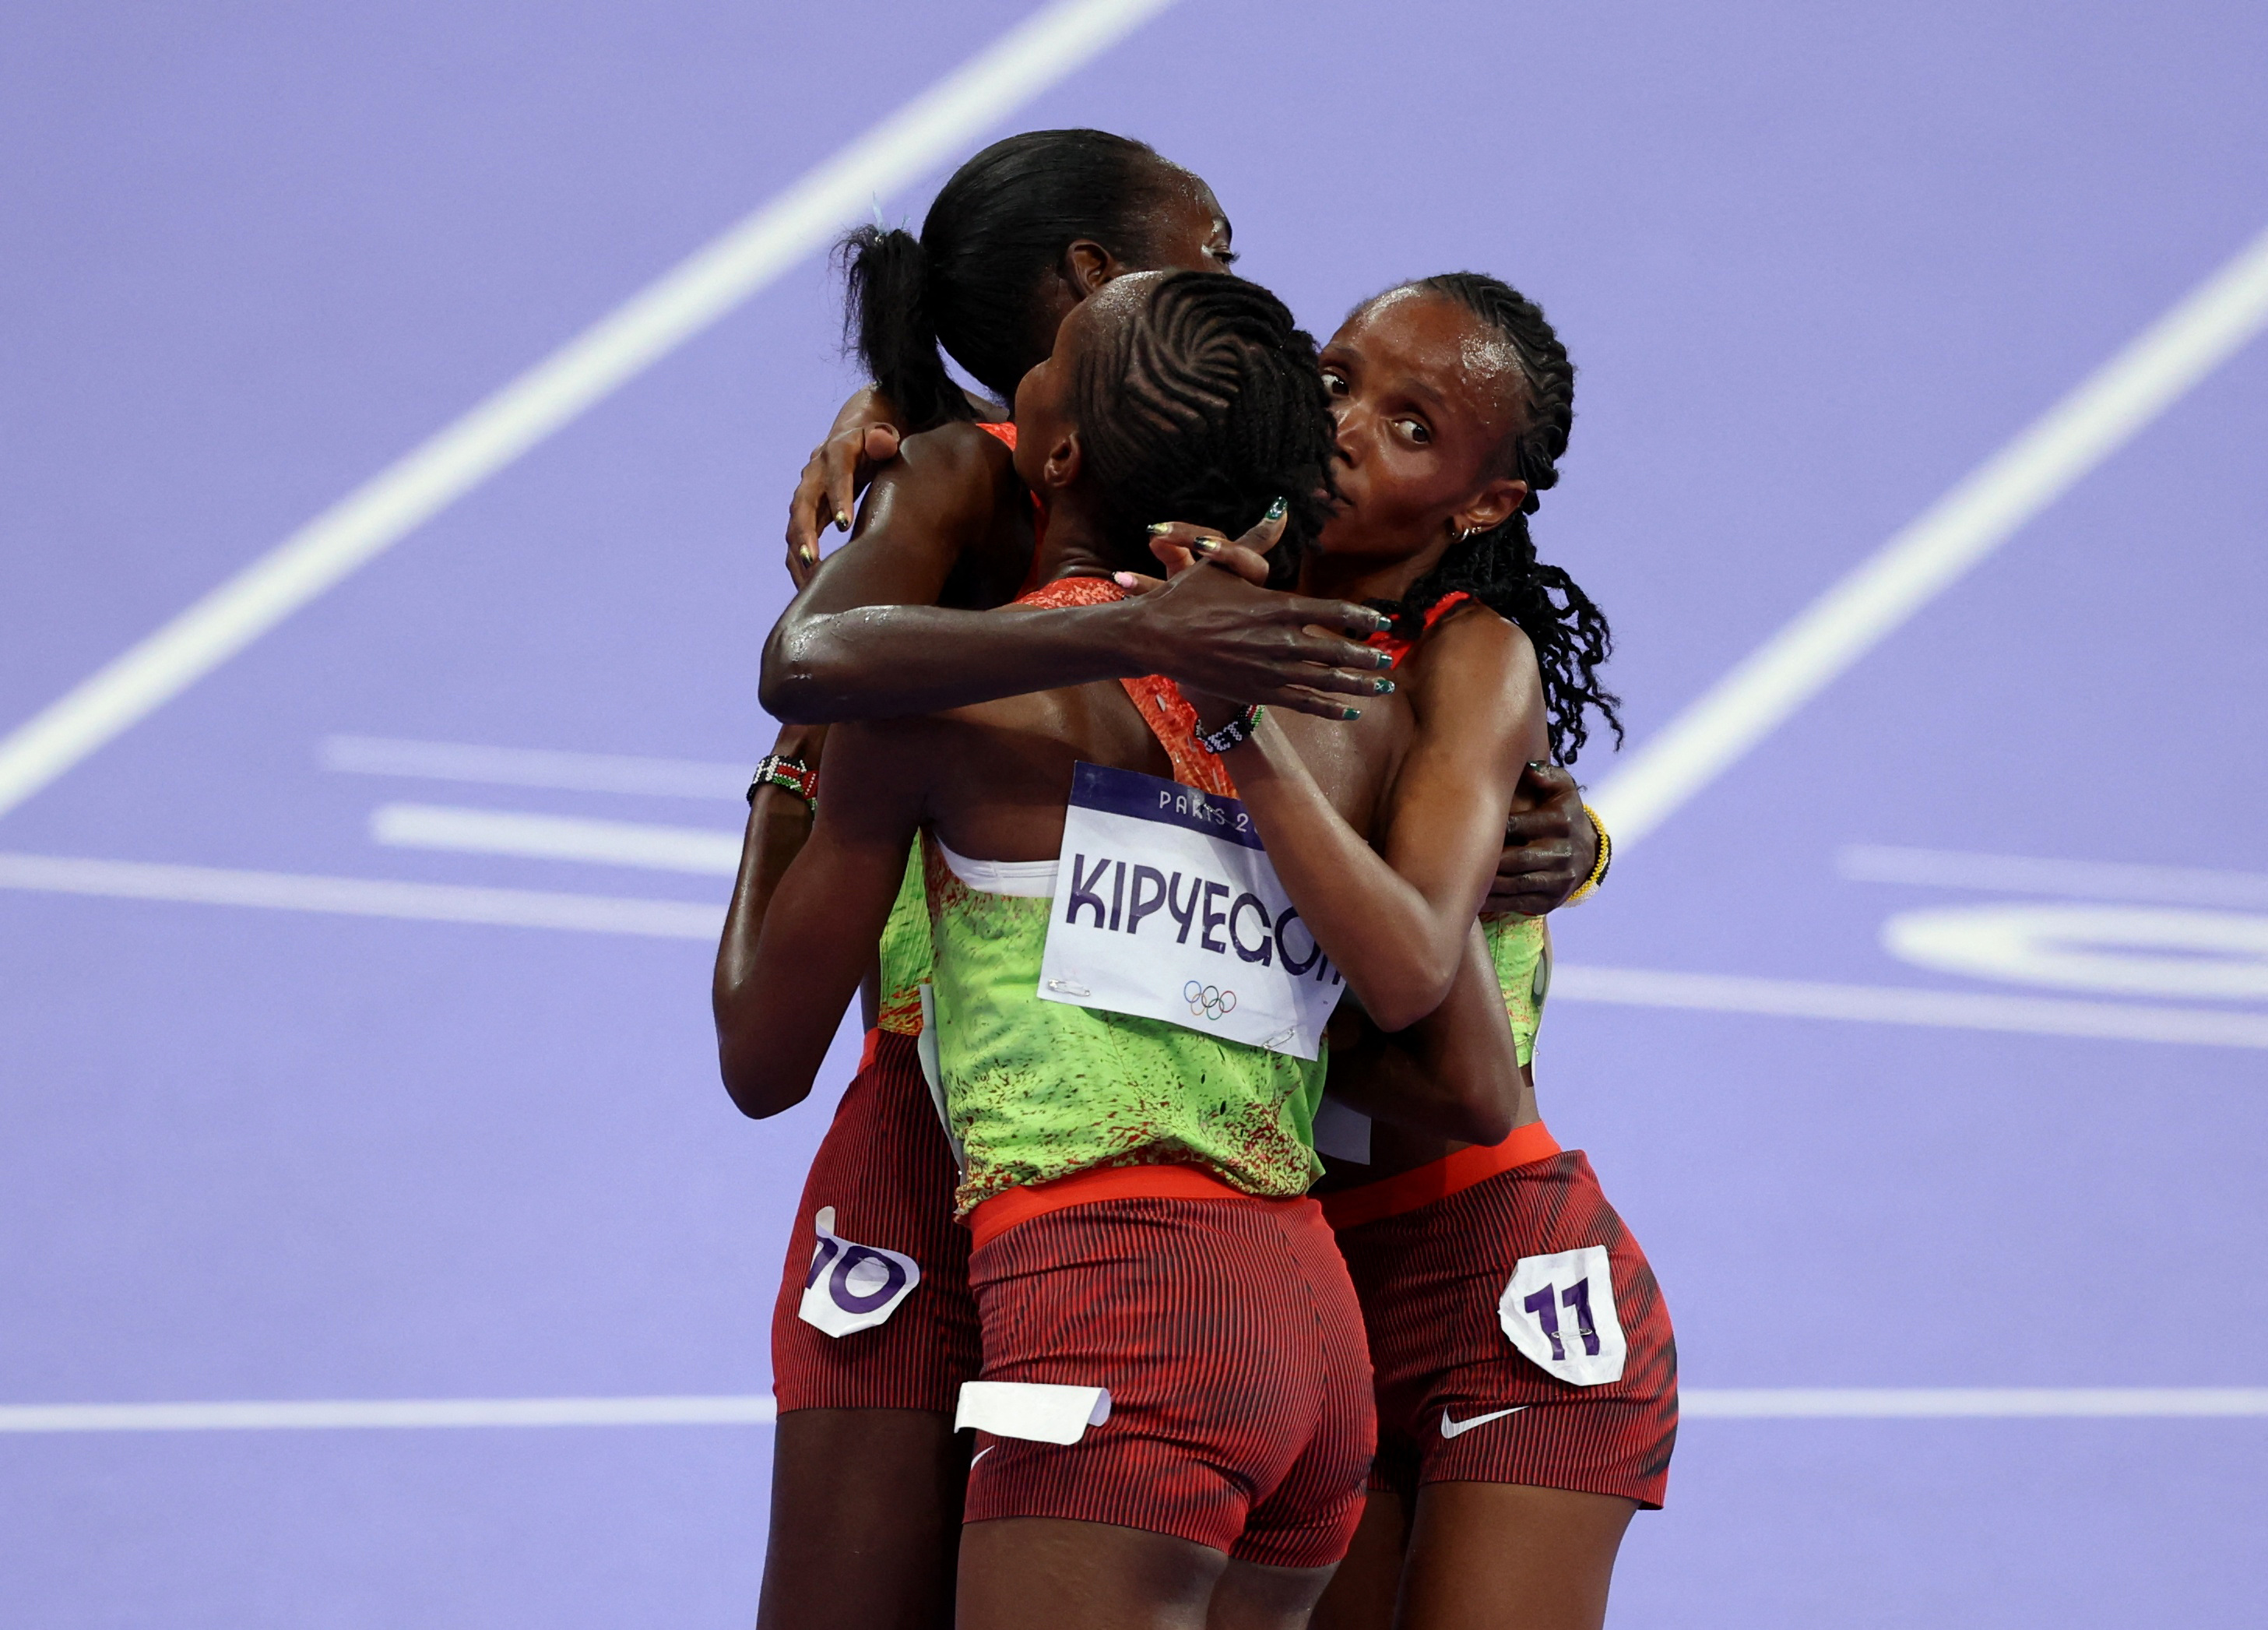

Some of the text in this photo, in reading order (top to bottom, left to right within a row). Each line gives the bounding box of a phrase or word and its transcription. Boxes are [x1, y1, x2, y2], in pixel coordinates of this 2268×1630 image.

[1159, 790, 1258, 834] PARIS 2
[1524, 1276, 1600, 1361] 11
